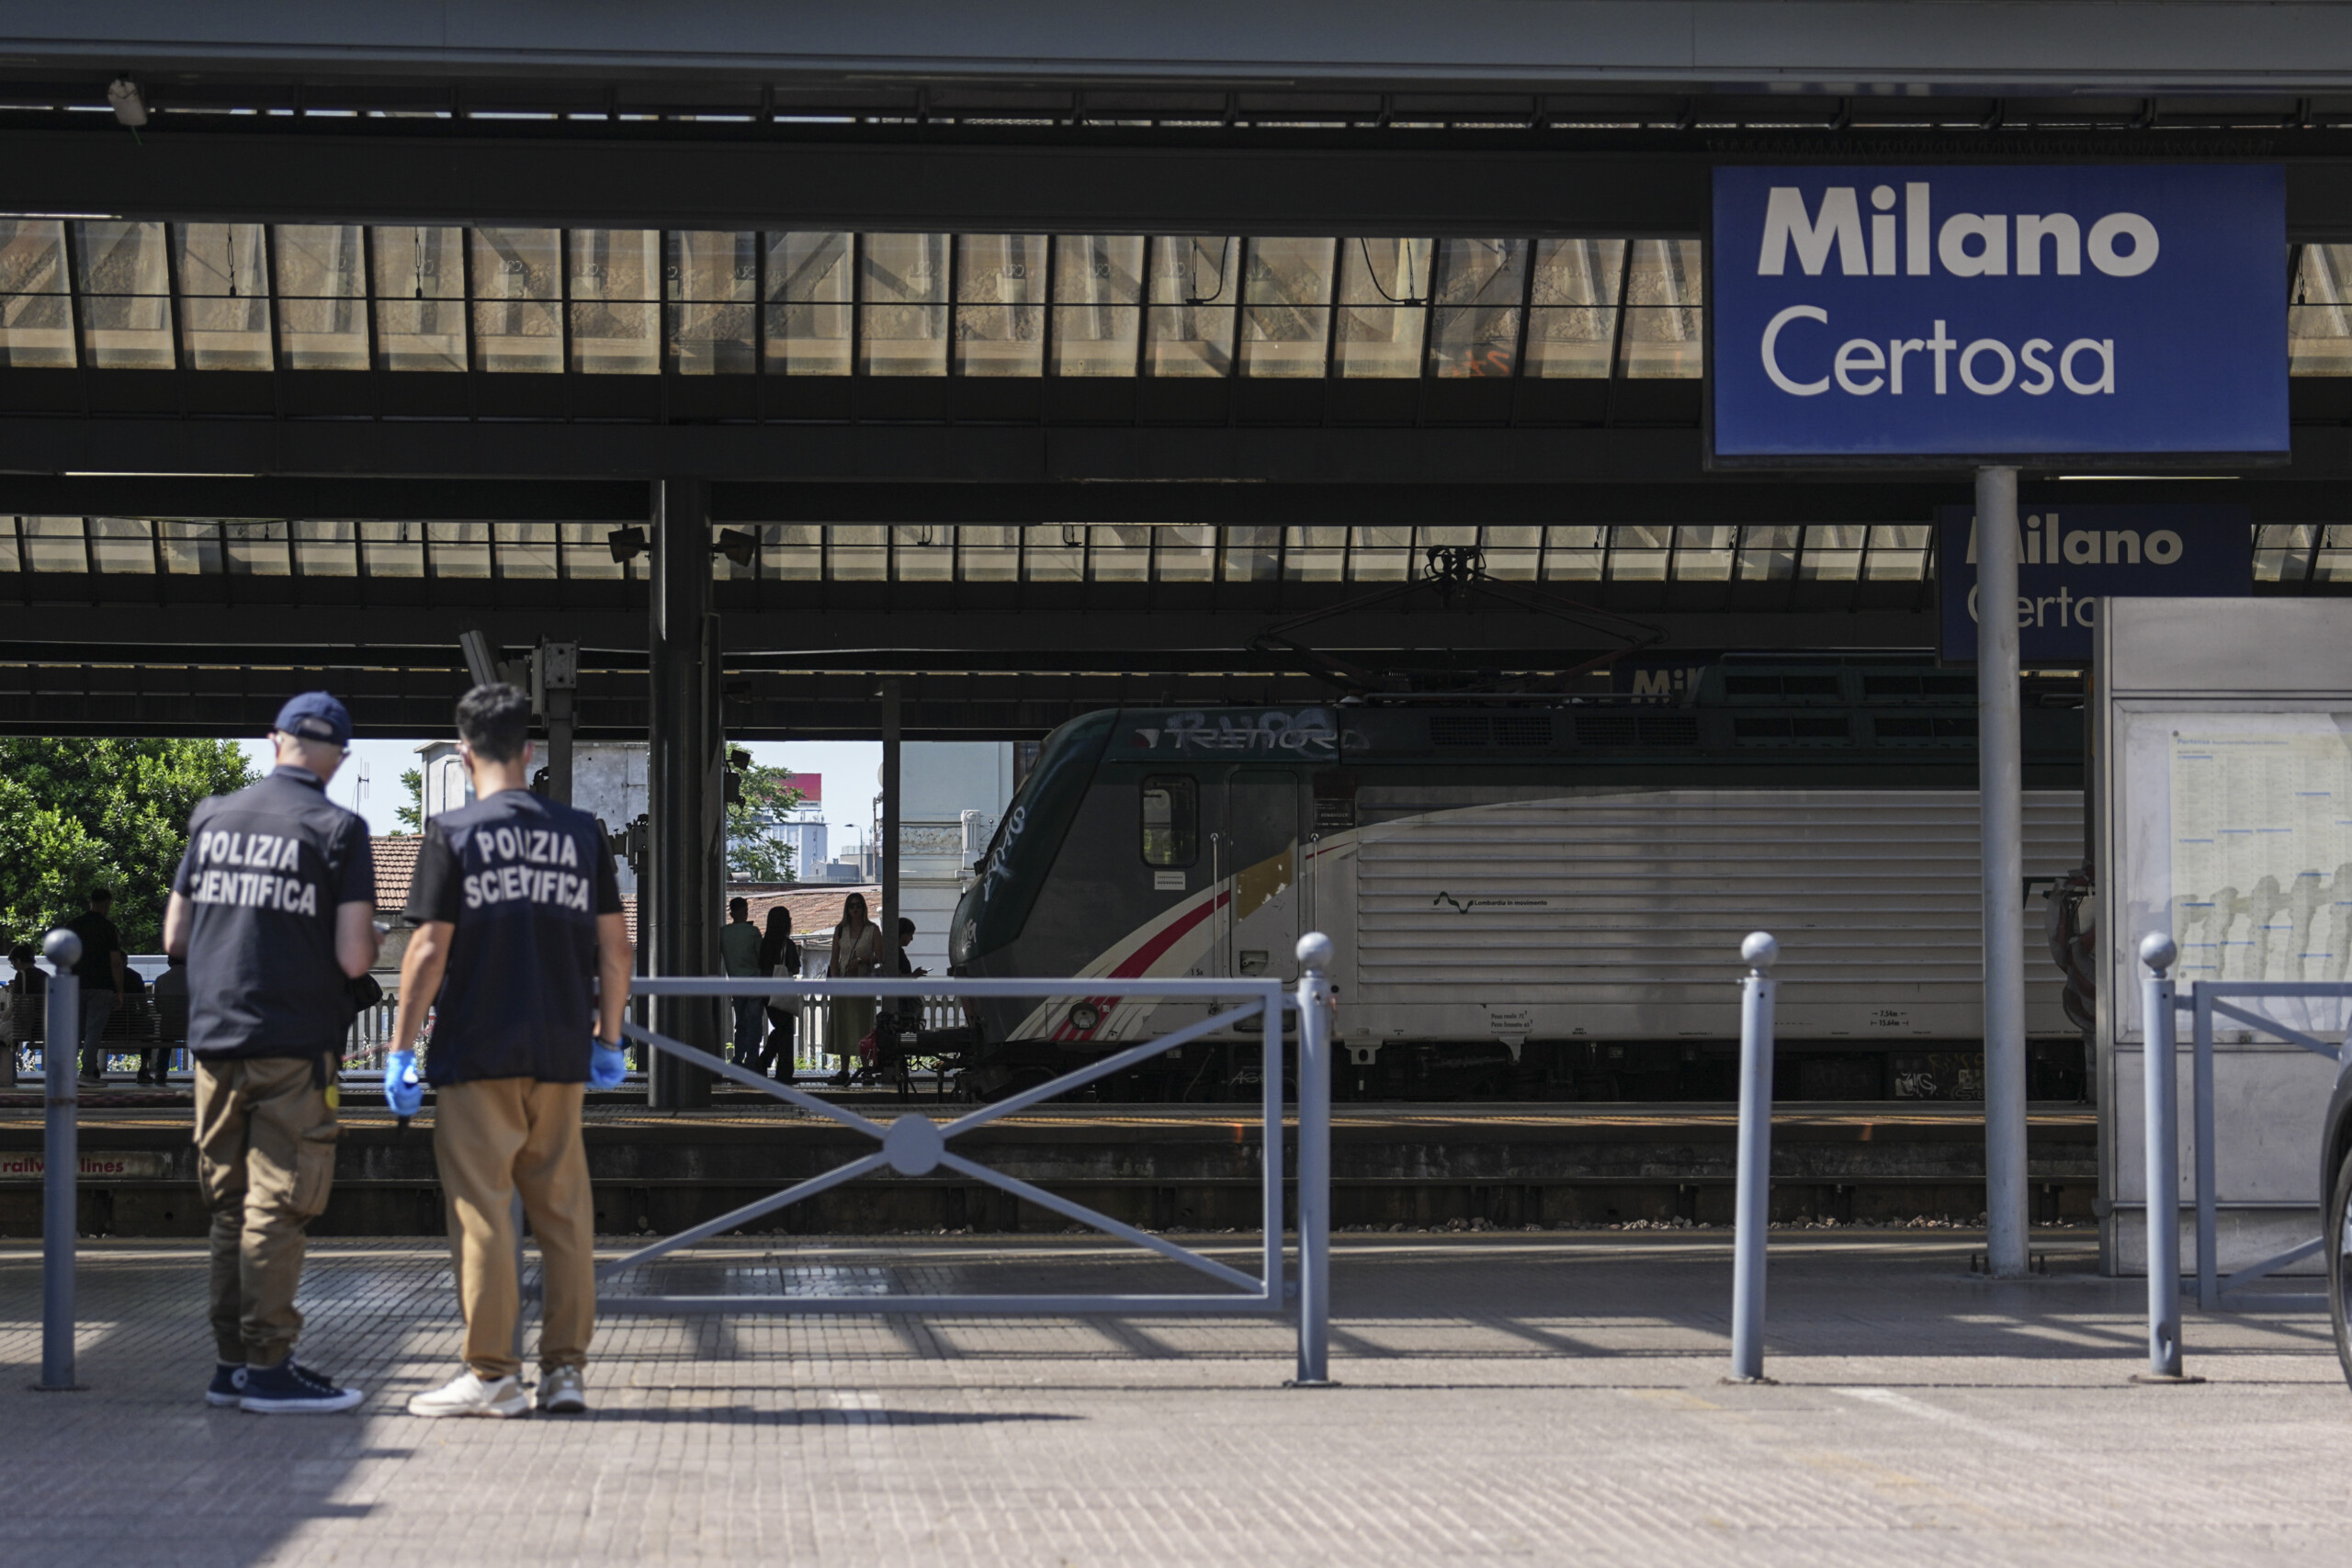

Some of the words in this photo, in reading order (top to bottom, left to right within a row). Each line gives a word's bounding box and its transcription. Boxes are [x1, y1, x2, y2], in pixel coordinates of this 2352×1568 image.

[1758, 182, 2160, 277] Milano
[1761, 305, 2115, 396] Certosa
[198, 830, 300, 872] POLIZIA
[81, 1157, 124, 1172] lines
